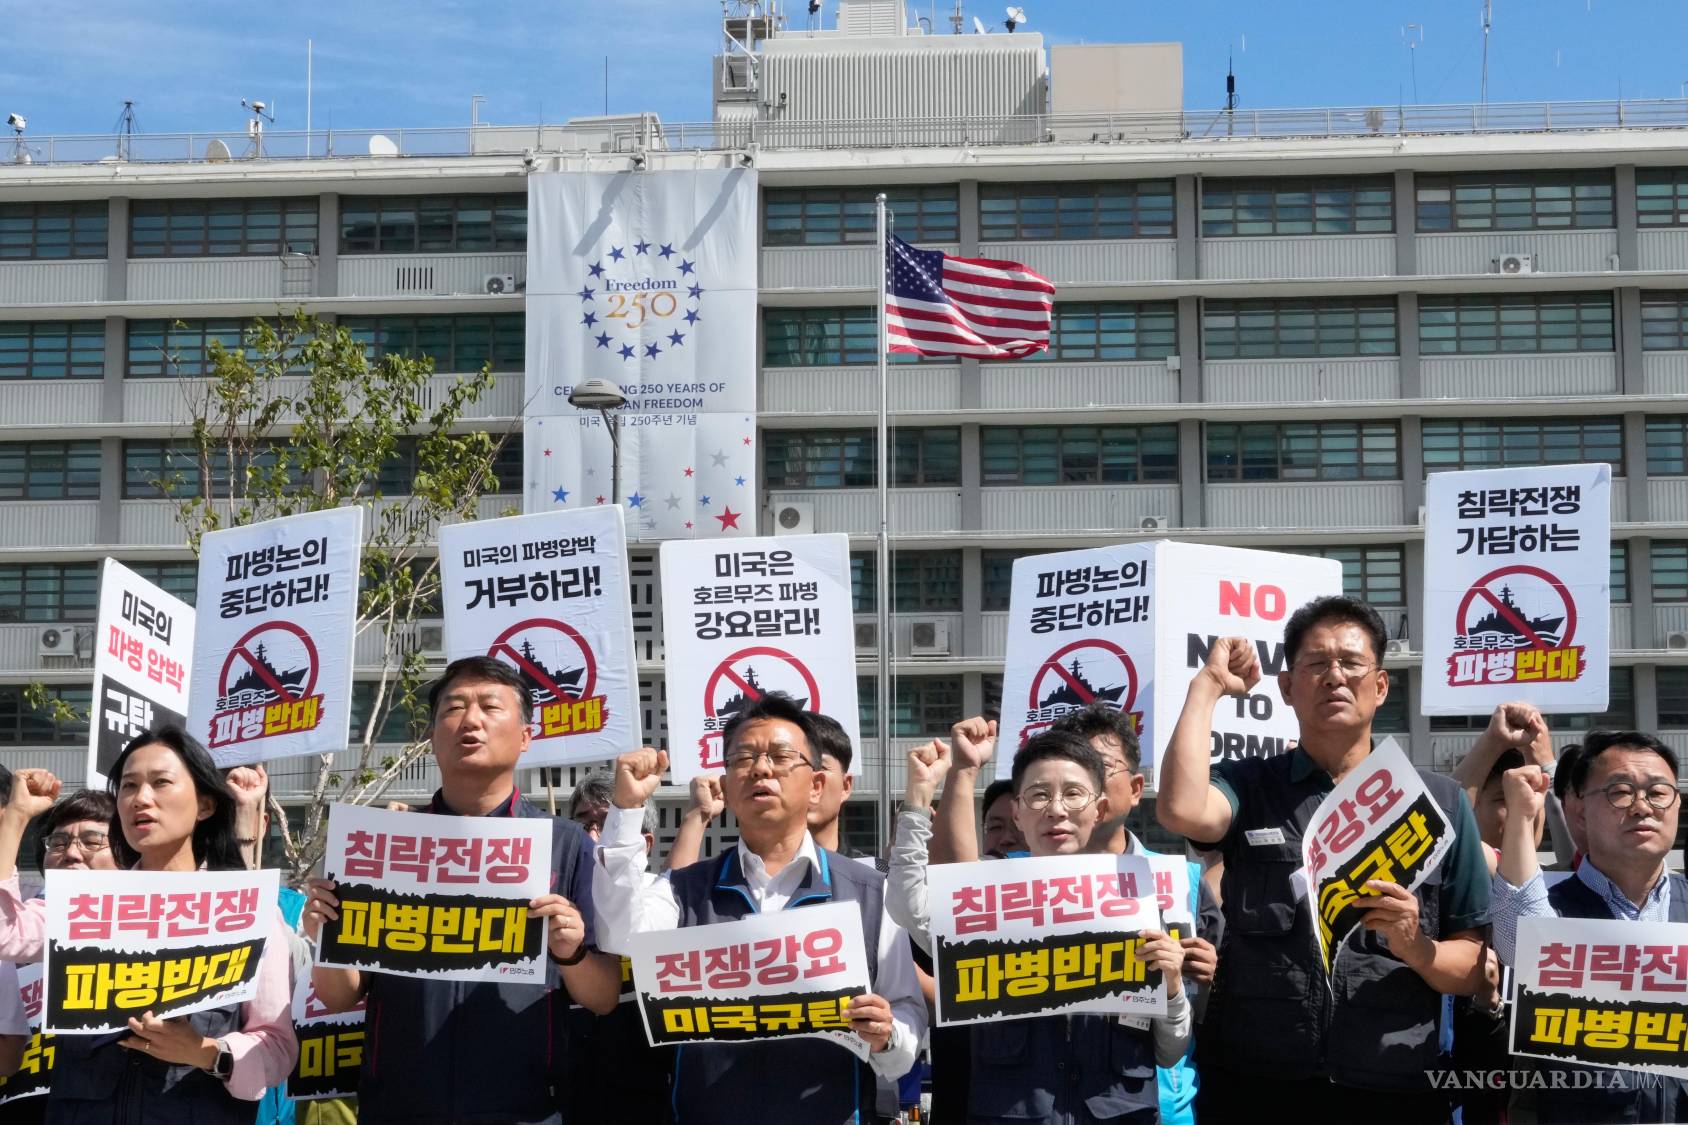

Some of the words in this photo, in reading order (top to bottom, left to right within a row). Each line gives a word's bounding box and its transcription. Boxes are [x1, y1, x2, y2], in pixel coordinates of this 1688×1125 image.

[605, 278, 677, 291] Freedom
[606, 292, 677, 328] 250
[641, 384, 663, 394] 250
[667, 383, 706, 393] YEARS
[709, 382, 726, 392] OF
[644, 398, 703, 409] FREEDOM
[580, 416, 600, 428] 미국
[630, 415, 672, 426] 250주년
[676, 413, 697, 426] 기념
[1457, 485, 1581, 519] 침략전쟁
[464, 544, 518, 568] 미국의
[522, 535, 597, 561] 파병압박
[1456, 523, 1580, 555] 가담하는
[225, 537, 328, 582] 파병논의
[715, 550, 795, 578] 미국은
[1036, 559, 1147, 599] 파병논의
[219, 574, 330, 619] 중단하라!
[464, 565, 603, 610] 거부하라!
[693, 583, 774, 606] 호르무즈
[778, 581, 818, 602] 파병
[1219, 579, 1287, 621] NO
[121, 589, 173, 646] 미국의
[694, 608, 822, 640] 강요말라!
[1030, 596, 1150, 634] 중단하라!
[108, 624, 144, 673] 파병
[147, 649, 185, 693] 압박
[1187, 632, 1288, 676] NV
[1453, 634, 1516, 650] 호르무즈
[1454, 647, 1578, 683] 파병반대
[105, 688, 154, 738] 규탄
[215, 692, 266, 712] 호르무즈
[215, 698, 318, 743] 파병반대
[532, 698, 601, 736] 반대
[1231, 693, 1273, 721] TO
[344, 831, 532, 884] 침략전쟁
[68, 887, 259, 940] 침략전쟁
[952, 871, 1141, 936] 침략전쟁
[337, 900, 528, 953] 파병반대
[62, 945, 251, 1010] 파병반대
[655, 928, 847, 993] 전쟁강요
[956, 939, 1146, 1003] 파병반대
[1538, 943, 1688, 992] 침략전
[663, 996, 851, 1033] 미국규탄
[1530, 1007, 1688, 1052] 파병반
